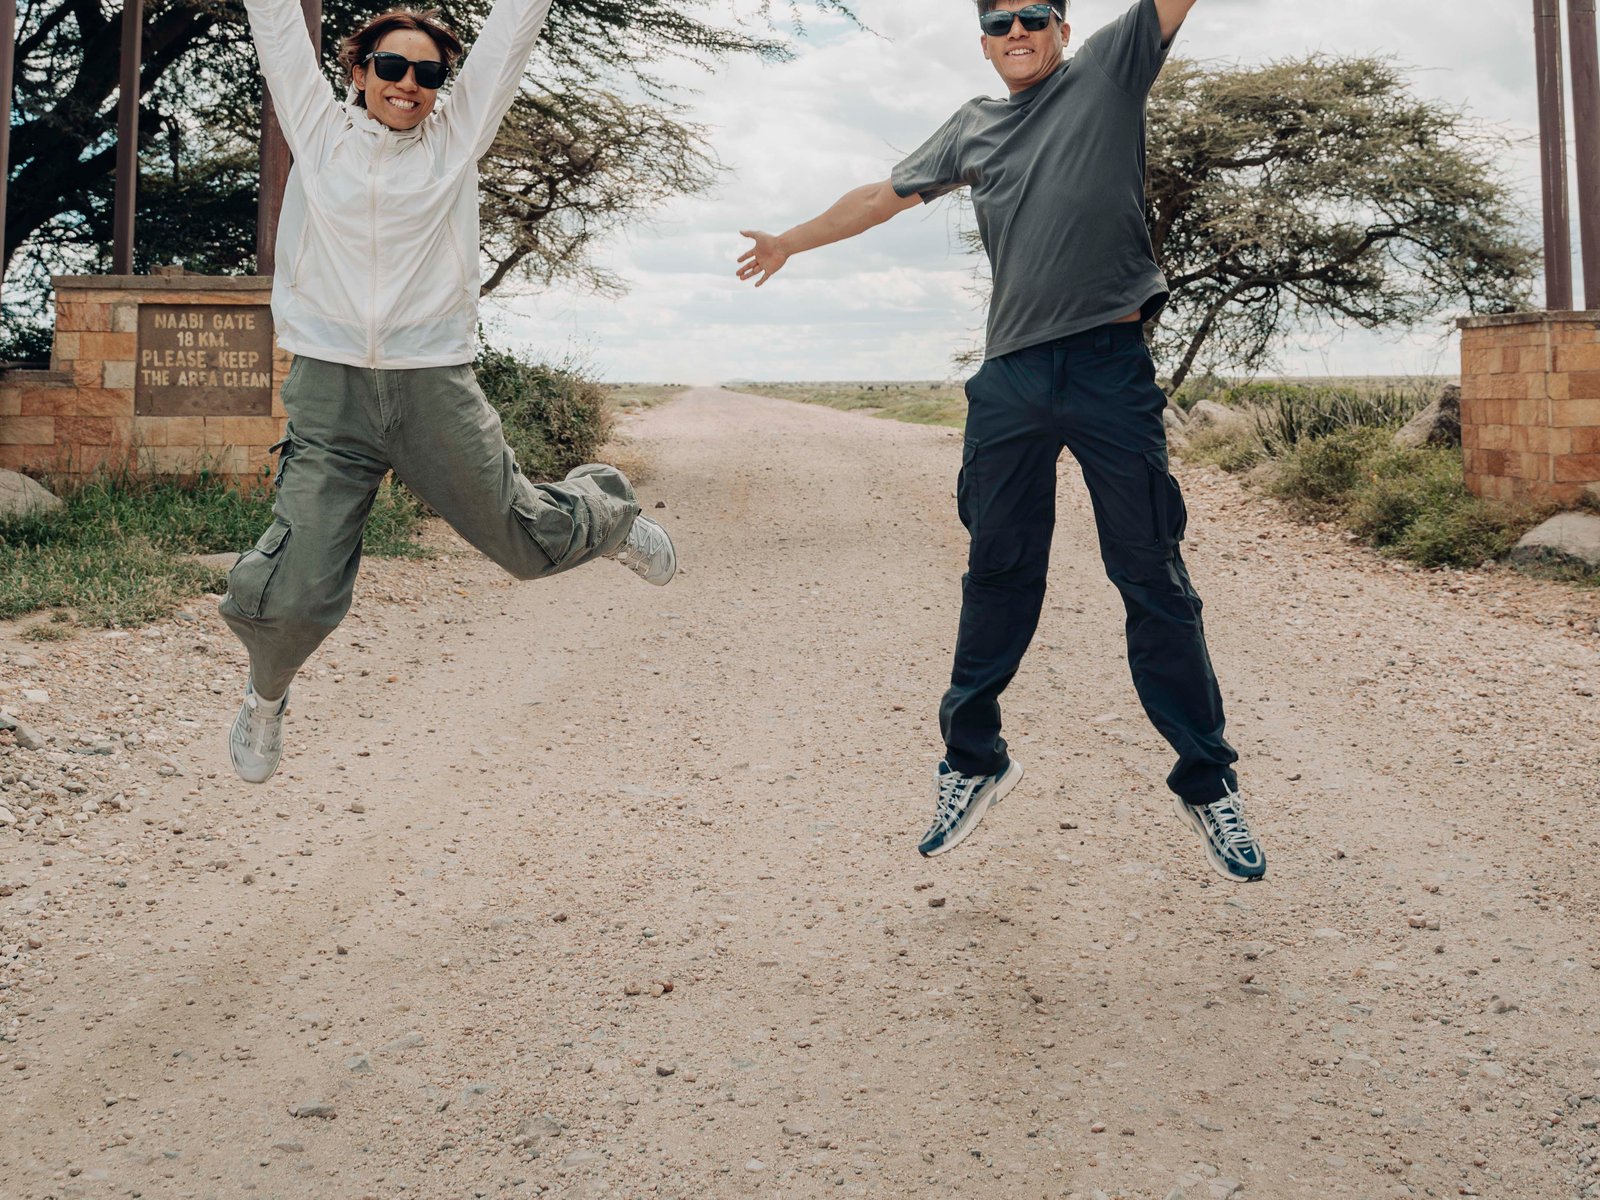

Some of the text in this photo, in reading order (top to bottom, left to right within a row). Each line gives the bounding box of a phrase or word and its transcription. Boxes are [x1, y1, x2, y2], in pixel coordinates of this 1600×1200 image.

[154, 313, 256, 330] NAABI GATE
[176, 331, 194, 347] 18
[142, 350, 259, 368] PLEASE KEEP
[141, 370, 170, 386] THE
[223, 372, 270, 388] CLEAN
